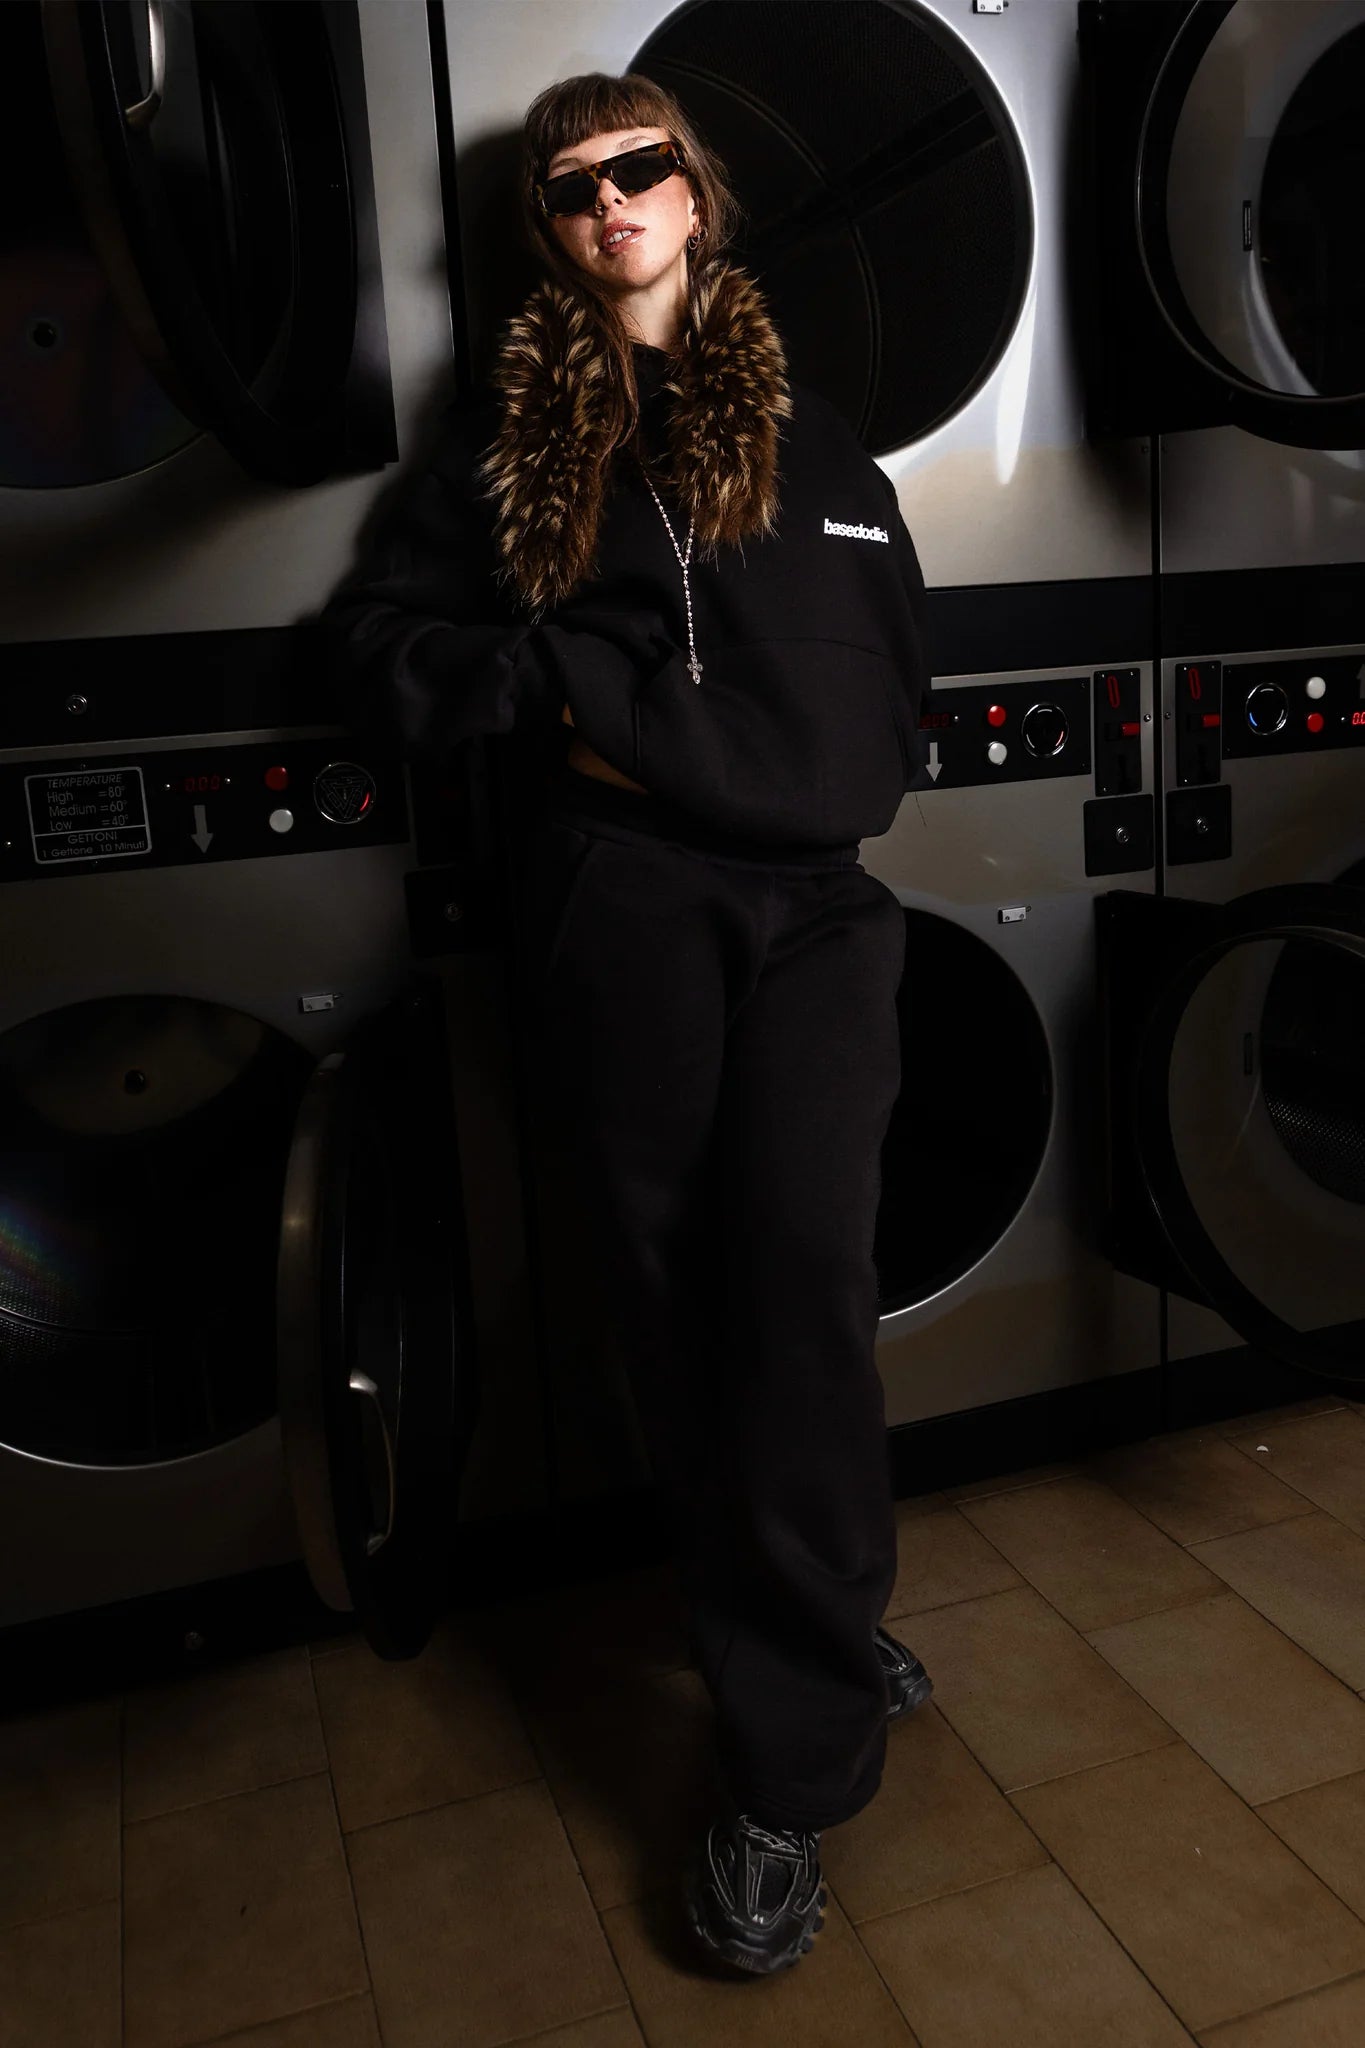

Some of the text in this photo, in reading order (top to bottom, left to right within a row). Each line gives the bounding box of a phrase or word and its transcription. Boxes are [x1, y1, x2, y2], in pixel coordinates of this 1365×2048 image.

[823, 518, 889, 543] basedodici
[47, 773, 123, 789] TEMPERATURE
[47, 791, 74, 805] High
[48, 803, 97, 818] Medium
[67, 831, 118, 845] GETTONI
[50, 846, 94, 857] Gettone
[100, 843, 112, 852] 10
[114, 840, 145, 852] Minuti
